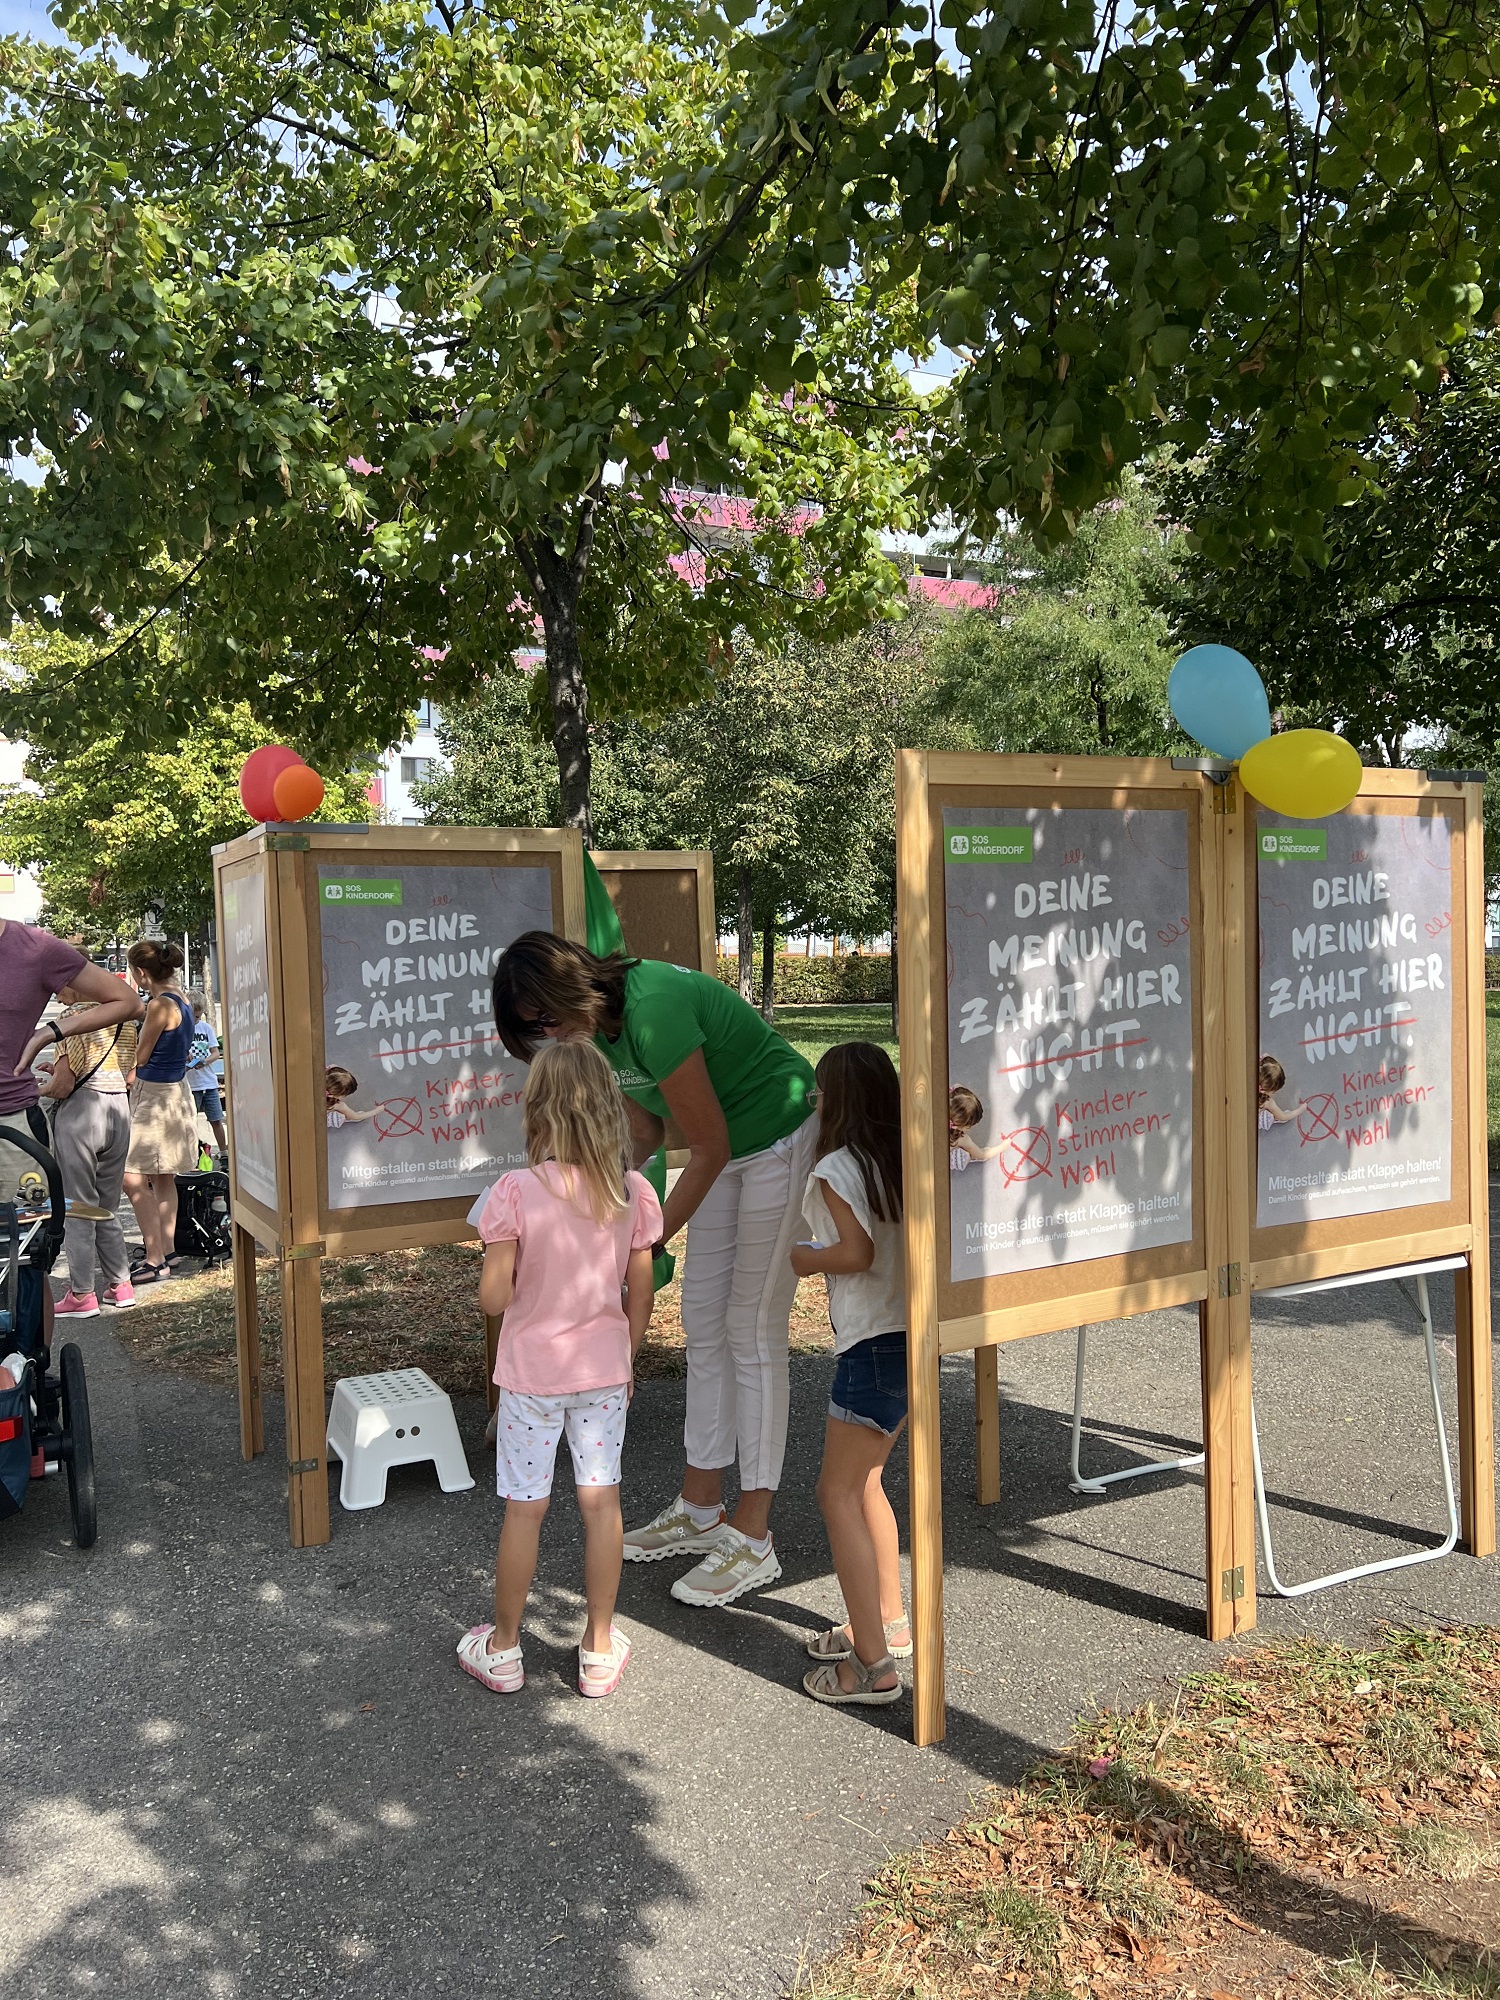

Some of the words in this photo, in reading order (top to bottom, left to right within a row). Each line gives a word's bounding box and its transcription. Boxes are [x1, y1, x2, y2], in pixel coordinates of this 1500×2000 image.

[972, 836, 988, 844] SOS
[972, 846, 1025, 855] KINDERDORF
[1279, 836, 1293, 844] SOS
[1279, 845, 1320, 854] KINDERDORF
[345, 884, 362, 892] SOS
[345, 892, 395, 900] KINDERDORF
[1014, 872, 1113, 918] DEINE
[1312, 870, 1391, 910] DEINE
[385, 912, 480, 946] DEINE
[1292, 911, 1417, 961] MEINUNG
[988, 918, 1147, 978] MEINUNG
[1268, 964, 1368, 1019] ZÄHLT
[1379, 952, 1445, 995] HIER
[334, 990, 454, 1036] ZÄHLT
[958, 980, 1086, 1044] ZÄHLT
[1098, 964, 1182, 1012] HIER
[426, 1071, 514, 1098] Kinder-
[1342, 1062, 1416, 1095] Kinder-
[1055, 1089, 1148, 1127] Kinder-
[1344, 1085, 1435, 1120] stimmen-
[431, 1117, 485, 1144] Wahl
[1058, 1113, 1171, 1156] stimmen-
[1344, 1118, 1390, 1150] Wahl
[342, 1160, 426, 1178] Mitgestalten
[428, 1158, 458, 1170] statt
[460, 1154, 504, 1168] Klappe
[1060, 1151, 1116, 1190] Wahl
[1269, 1170, 1339, 1192] Mitgestalten
[1340, 1167, 1366, 1182] statt
[1368, 1163, 1405, 1180] Klappe
[1406, 1156, 1442, 1174] halten!
[342, 1182, 364, 1190] Damit
[365, 1180, 388, 1188] Kinder
[390, 1178, 416, 1186] gesund
[1288, 1192, 1308, 1202] Kinder
[1308, 1189, 1330, 1200] gesund
[966, 1212, 1054, 1240] Mitgestalten
[1056, 1208, 1087, 1226] statt
[1090, 1202, 1136, 1221] Klappe
[1138, 1192, 1180, 1212] halten!
[966, 1244, 989, 1254] Damit
[990, 1239, 1015, 1251] Kinder
[1016, 1234, 1044, 1248] gesund
[1091, 1223, 1118, 1235] müssen
[1119, 1221, 1129, 1230] sie
[1130, 1216, 1152, 1230] gehört
